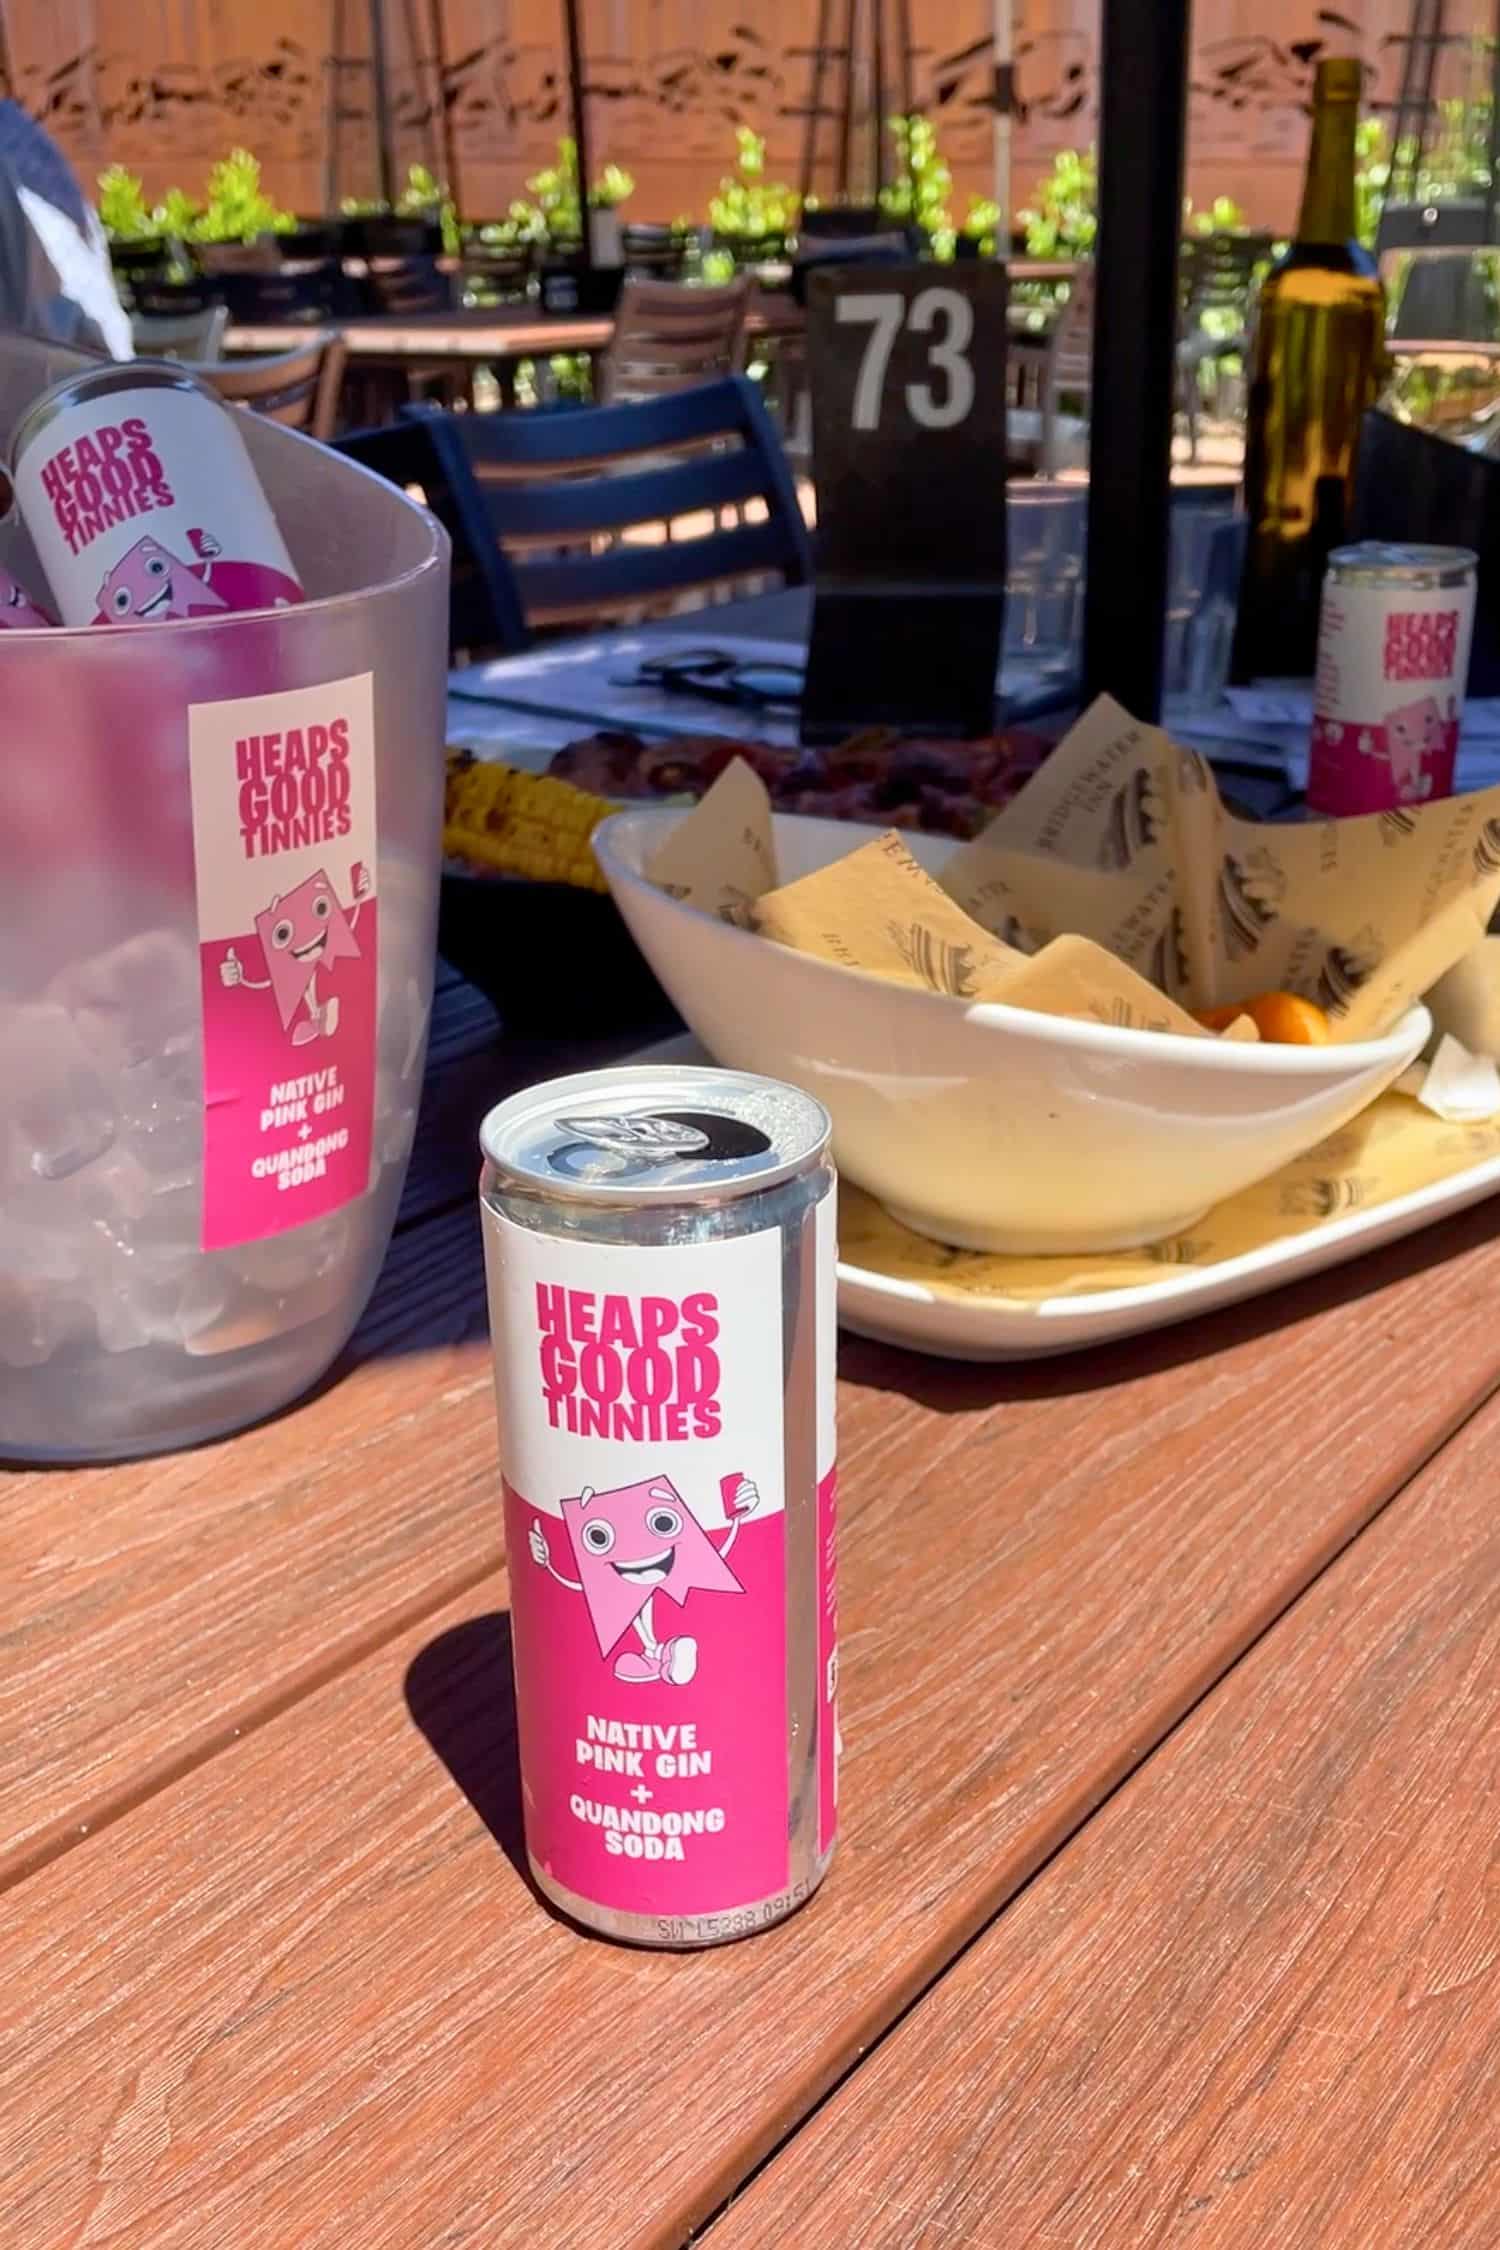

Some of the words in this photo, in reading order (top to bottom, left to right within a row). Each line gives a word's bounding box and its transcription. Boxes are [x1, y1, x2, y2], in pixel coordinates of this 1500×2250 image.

[836, 287, 975, 430] 73
[41, 419, 152, 498] HEAPS
[55, 450, 162, 531] GOOD
[65, 482, 174, 555] TINNIES
[235, 718, 349, 780] HEAPS
[240, 761, 350, 829] GOOD
[240, 804, 351, 860] TINNIES
[260, 1100, 309, 1132] PINK
[313, 1084, 344, 1115] GIN
[270, 1066, 338, 1107] NATIVE
[252, 1128, 348, 1178] QUANDONG
[278, 1158, 326, 1191] SODA
[536, 1281, 720, 1350] HEAPS
[540, 1334, 721, 1405] GOOD
[543, 1387, 722, 1442] TINNIES
[576, 1739, 645, 1777] PINK
[655, 1750, 712, 1778] GIN
[587, 1715, 697, 1751] NATIVE
[570, 1794, 725, 1836] QUANDONG
[605, 1831, 685, 1861] SODA
